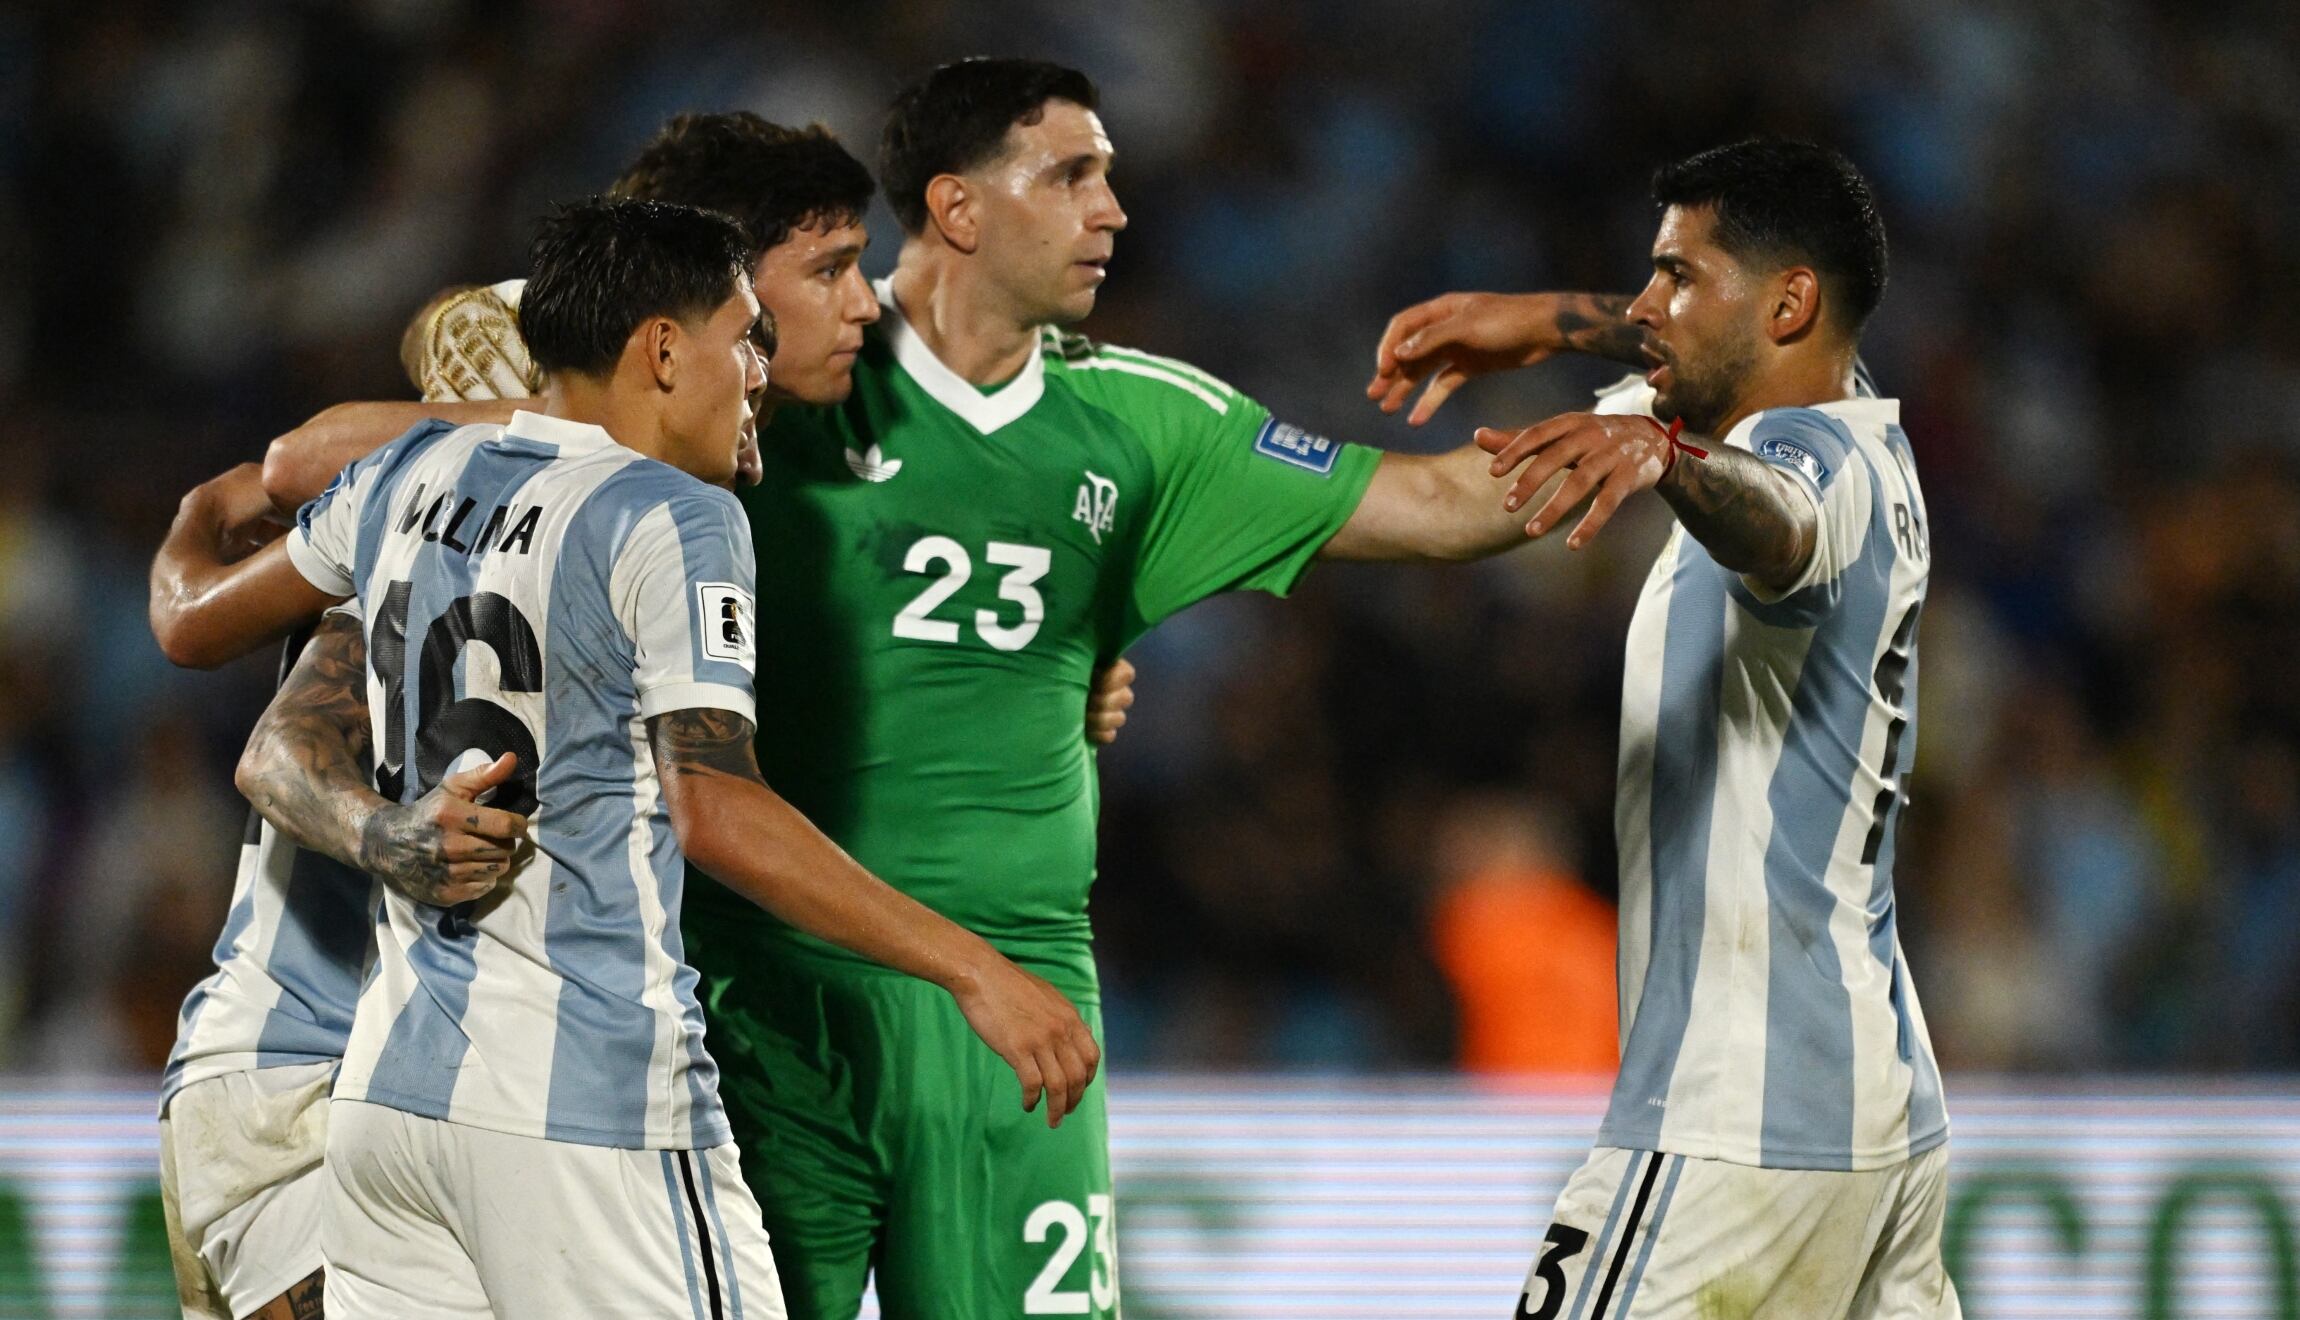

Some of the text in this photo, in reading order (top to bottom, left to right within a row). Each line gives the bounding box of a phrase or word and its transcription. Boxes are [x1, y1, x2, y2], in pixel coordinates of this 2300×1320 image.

[892, 535, 1052, 652] 23
[370, 579, 542, 828] 16
[1023, 1194, 1115, 1315] 23
[1515, 1222, 1589, 1320] 3
